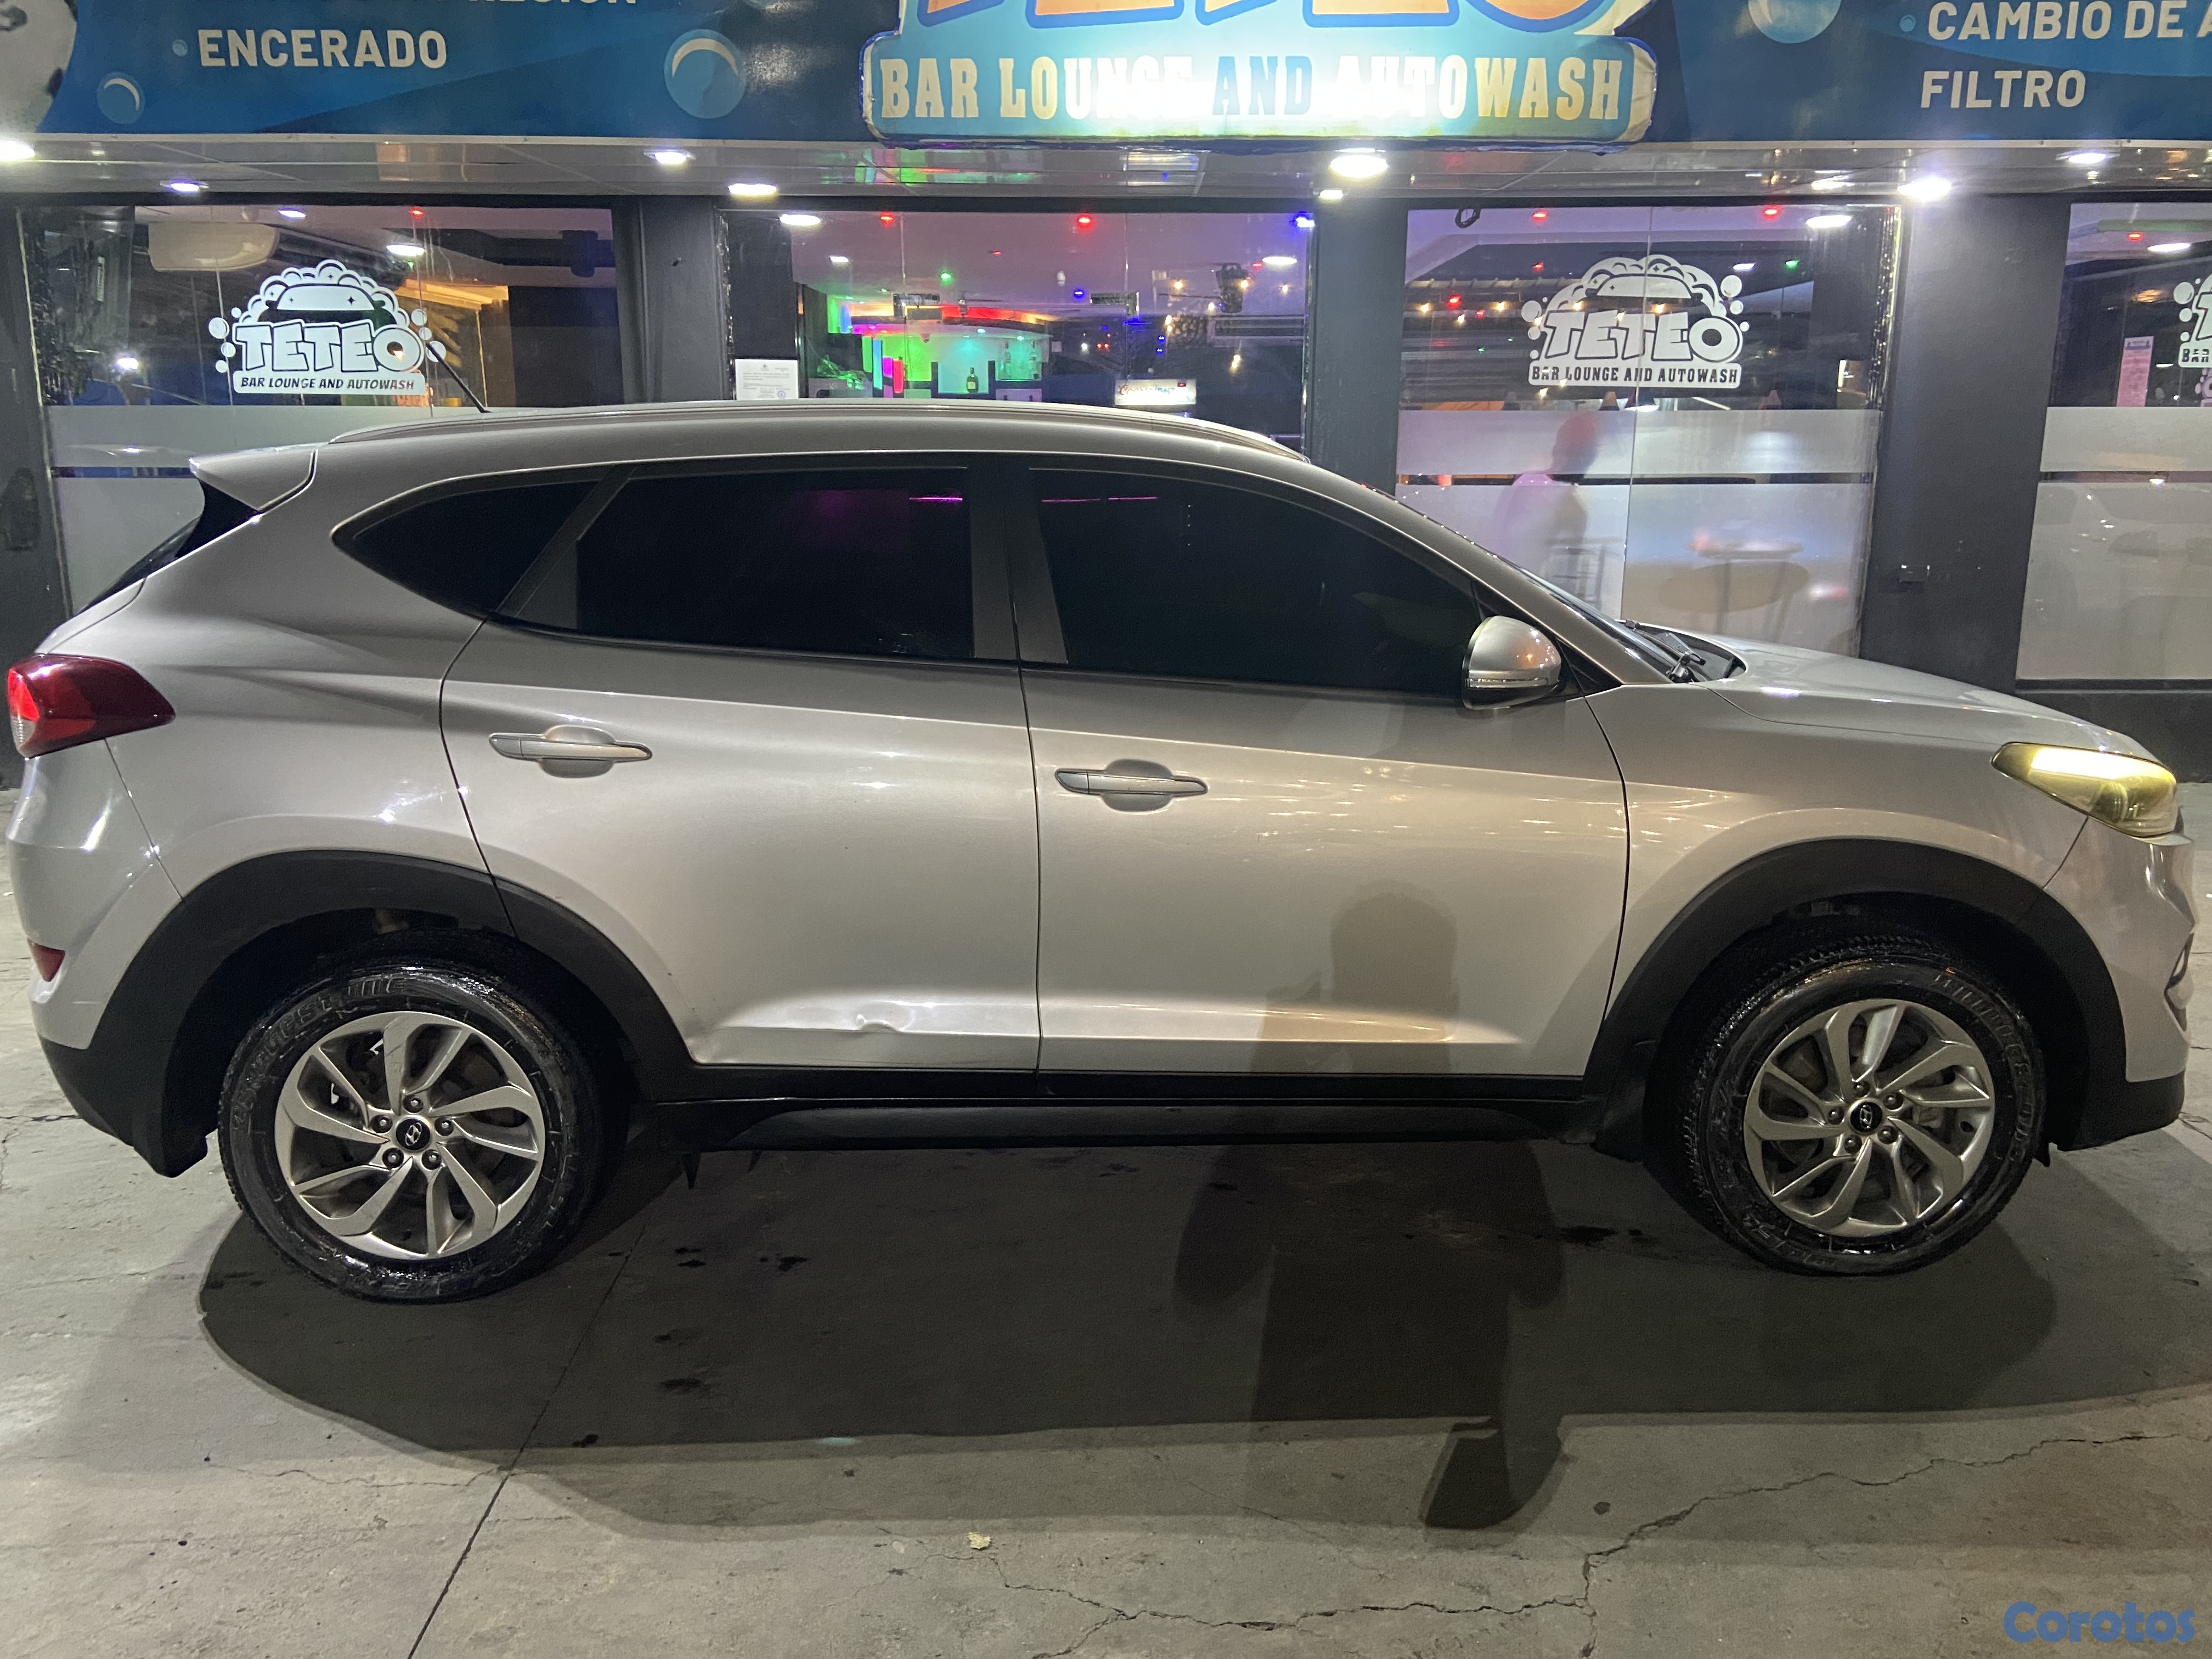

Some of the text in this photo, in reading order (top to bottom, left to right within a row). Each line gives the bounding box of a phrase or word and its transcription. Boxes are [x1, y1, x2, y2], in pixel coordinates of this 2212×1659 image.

[1928, 1, 2112, 40] CAMBIO
[2124, 0, 2187, 38] DE
[198, 29, 447, 69] ENCERADO
[880, 58, 979, 118] BAR
[1212, 55, 1312, 115] AND
[1921, 70, 2086, 109] FILTRO
[235, 321, 421, 373] TETEO
[1543, 309, 1741, 363] TETEO
[241, 377, 414, 390] BAR LOUNGE AND AUTOWASH
[1532, 366, 1738, 384] BAR LOUNGE AND AUTOWASH
